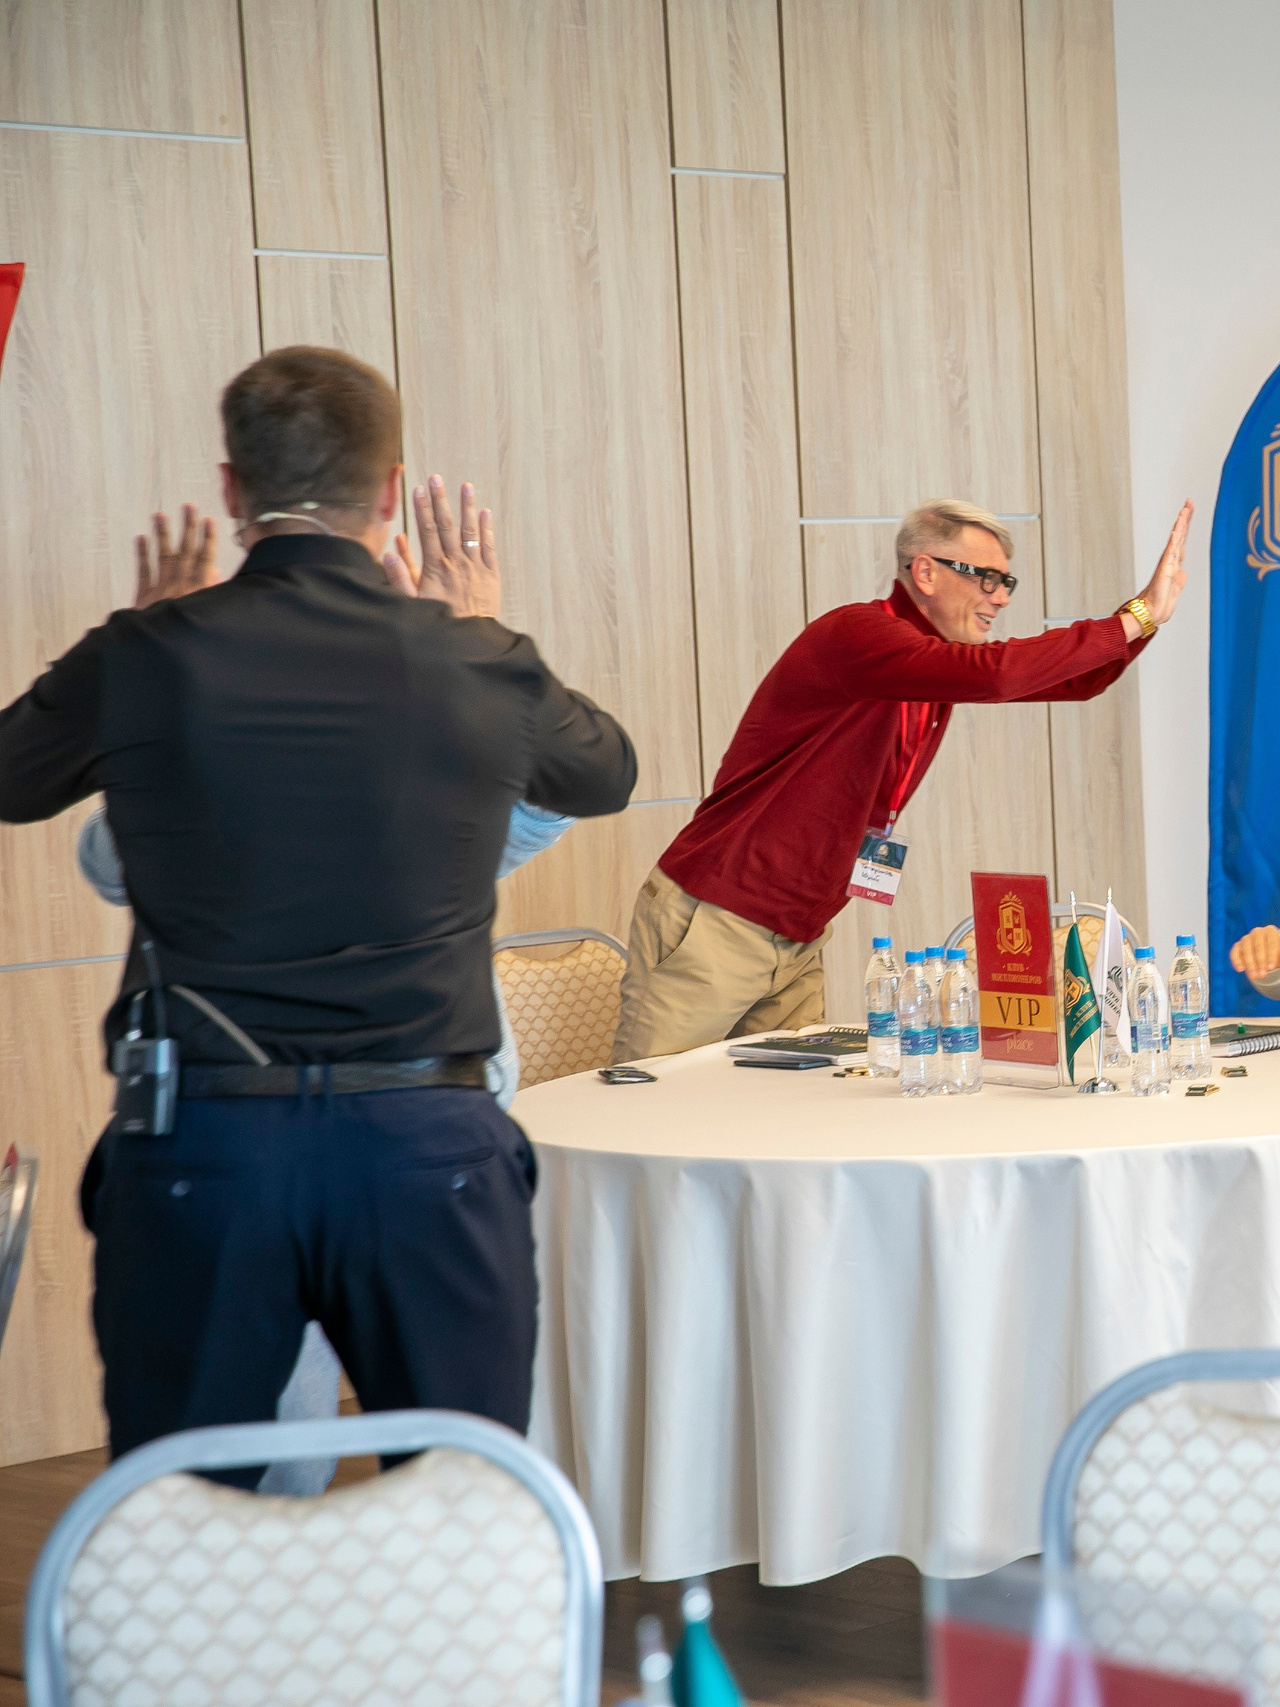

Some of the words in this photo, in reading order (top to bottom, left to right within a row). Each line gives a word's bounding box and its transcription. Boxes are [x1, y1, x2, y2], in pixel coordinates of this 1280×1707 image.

[866, 890, 877, 898] VIP
[996, 996, 1040, 1027] VIP
[1006, 1035, 1034, 1054] place
